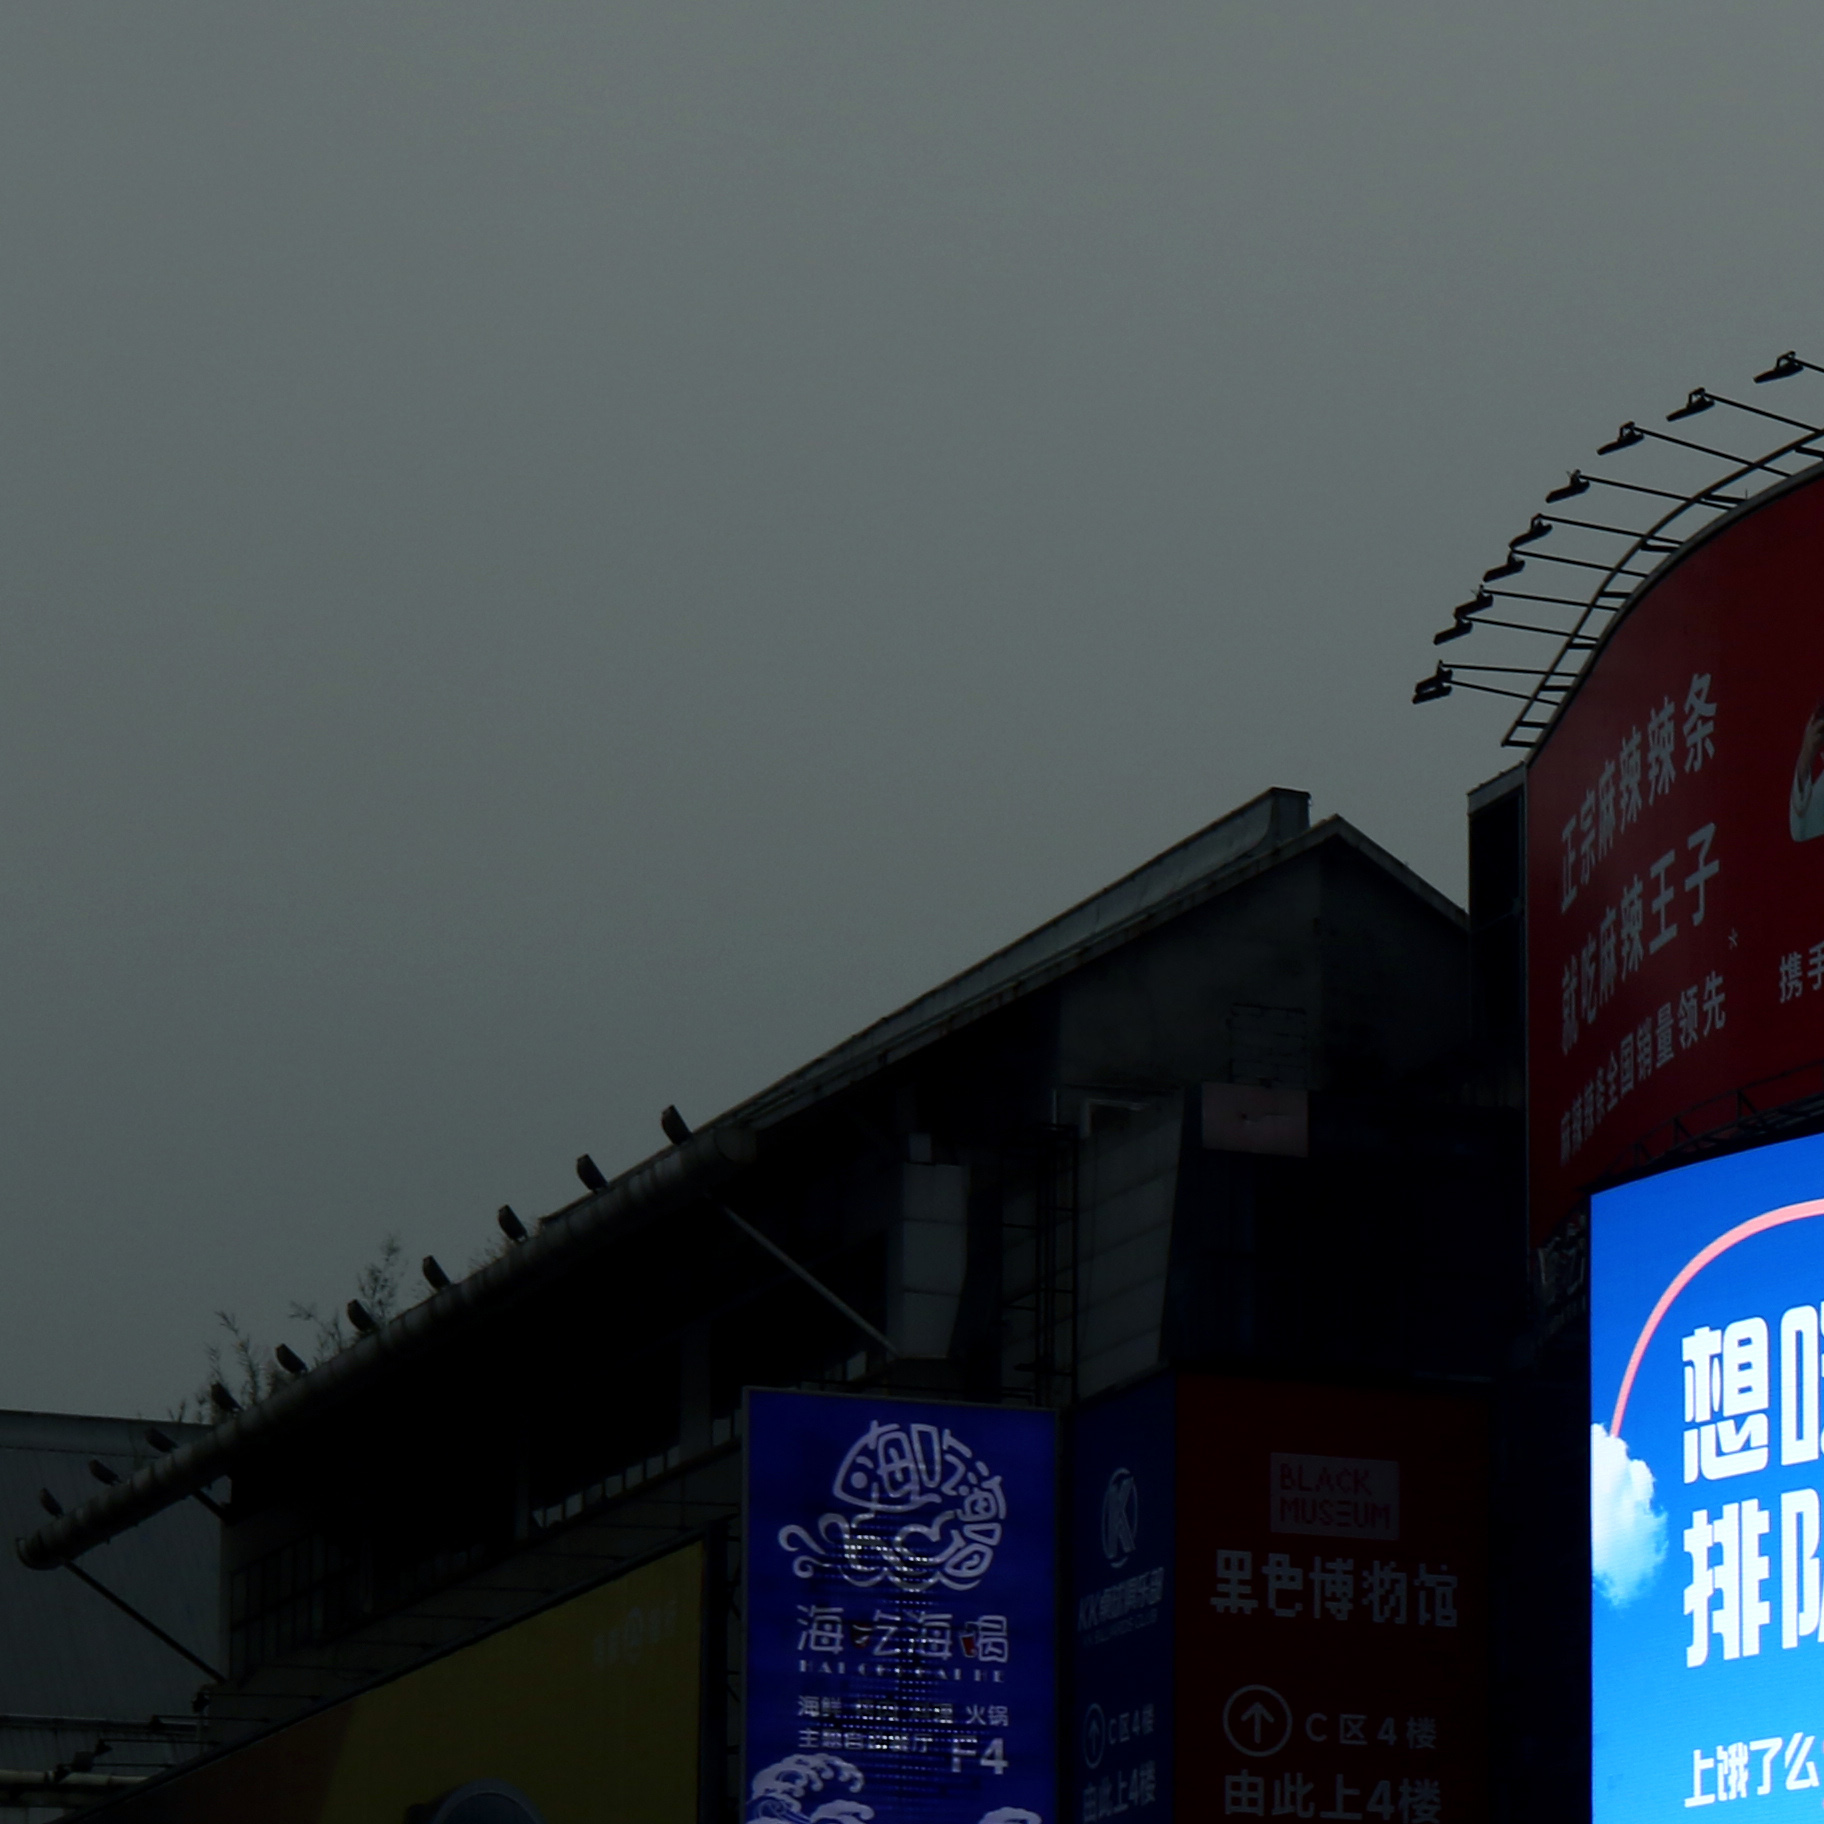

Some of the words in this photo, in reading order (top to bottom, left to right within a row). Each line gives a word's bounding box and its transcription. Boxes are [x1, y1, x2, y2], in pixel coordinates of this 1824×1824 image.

[1280, 1463, 1373, 1498] BLACK
[1280, 1496, 1392, 1531] MUSEUM
[1210, 1548, 1459, 1629] 黑色博物馆
[966, 1703, 1009, 1728] 火锅
